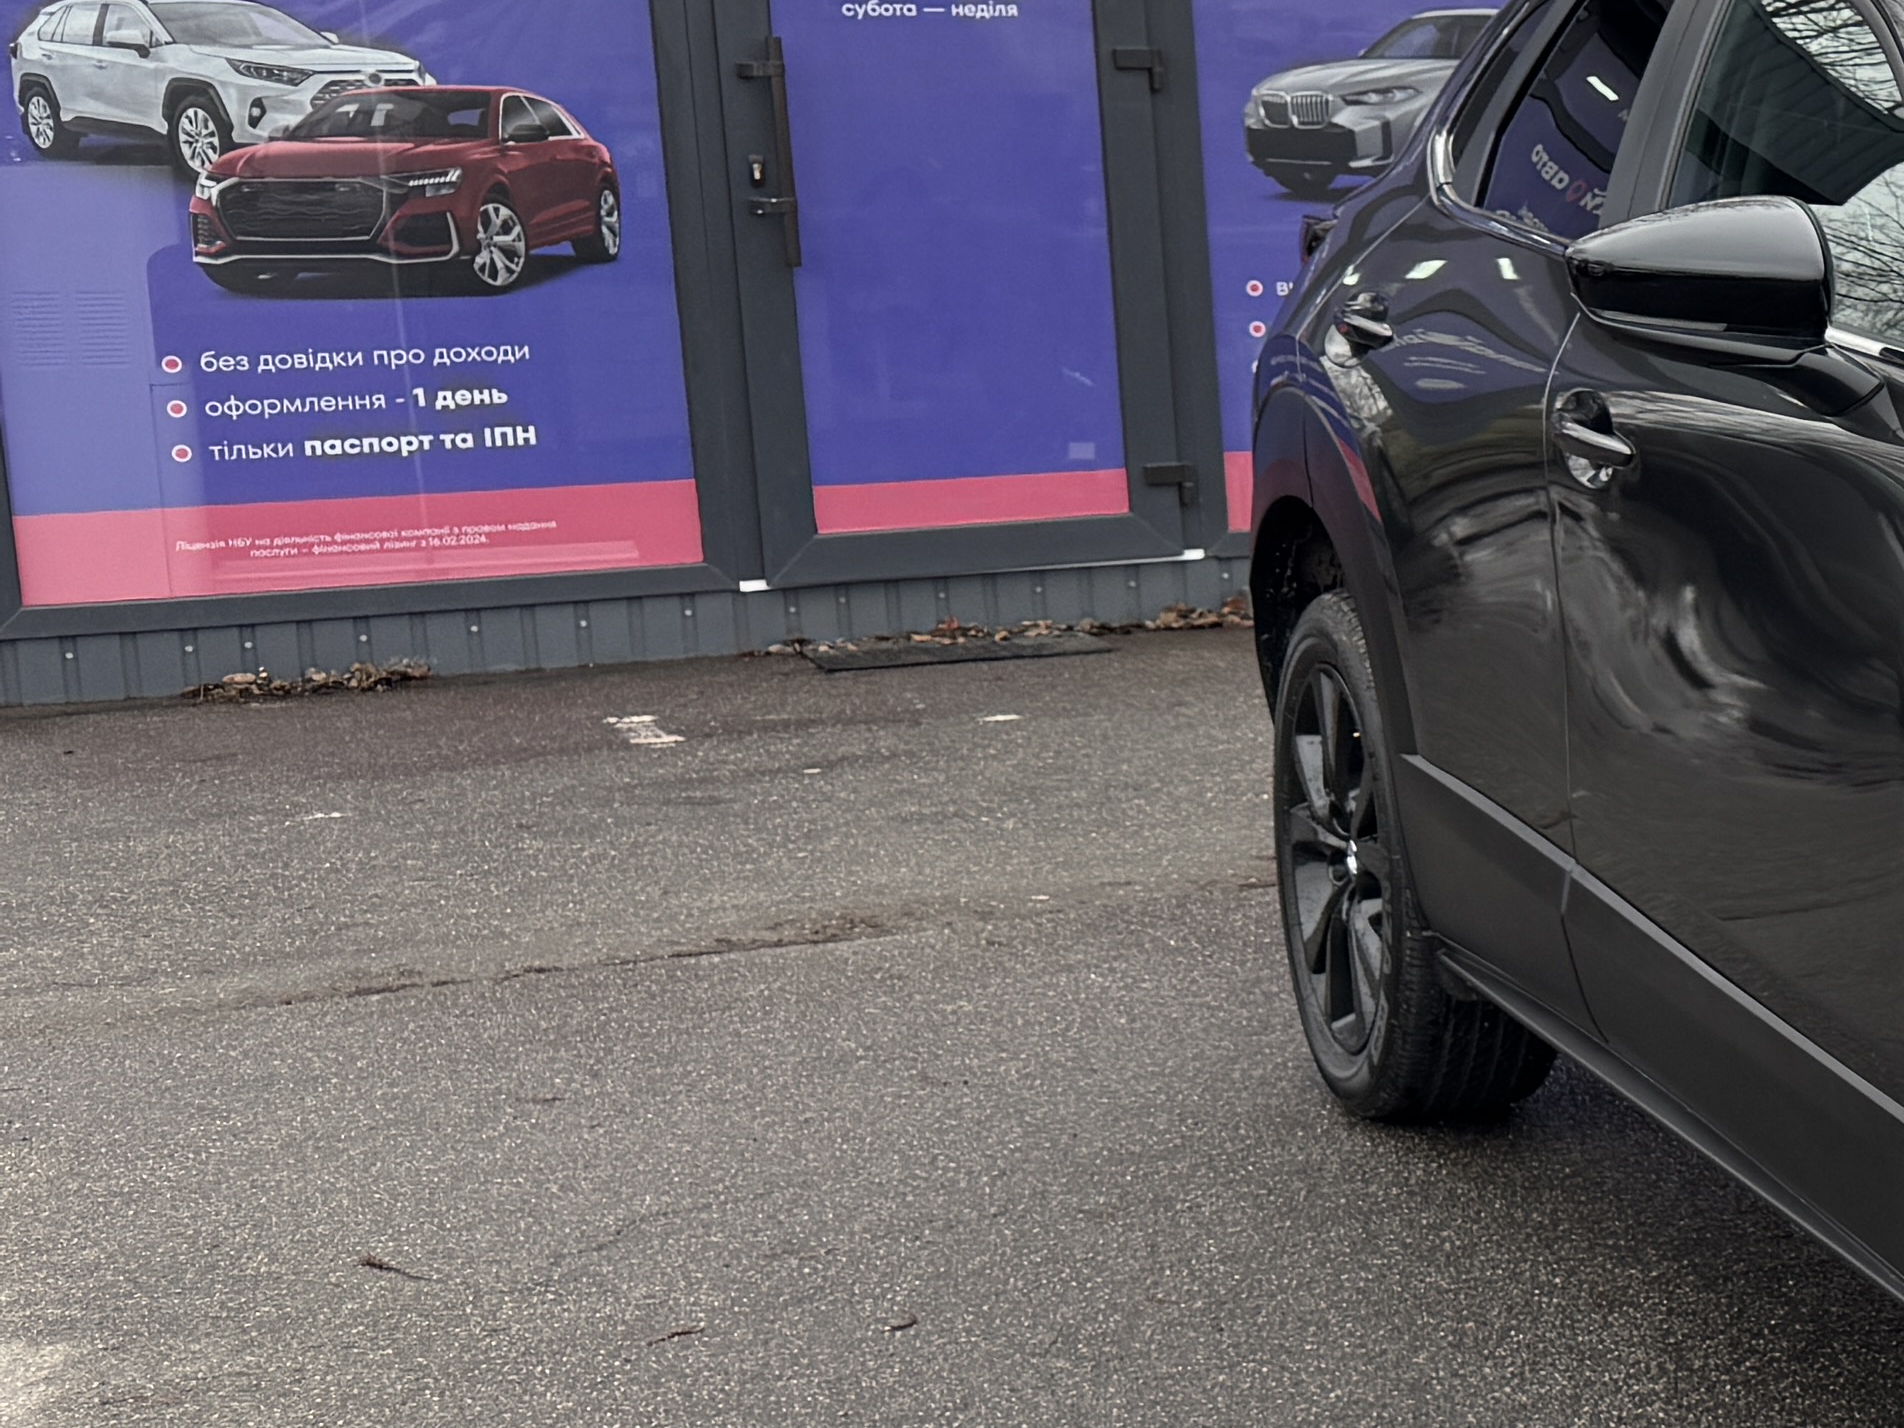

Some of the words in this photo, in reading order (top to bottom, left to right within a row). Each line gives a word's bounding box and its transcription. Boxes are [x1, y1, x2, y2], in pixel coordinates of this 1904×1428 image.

[841, 0, 917, 21] субота
[950, 0, 1019, 20] неділя
[199, 350, 250, 374] без
[257, 346, 365, 374] довідки
[372, 347, 426, 369] про
[432, 340, 531, 369] доходи
[204, 391, 387, 420] оформлення
[413, 387, 427, 408] 1
[434, 386, 509, 412] день
[208, 437, 295, 463] тільки
[303, 430, 435, 464] паспорт
[438, 429, 475, 451] та
[483, 424, 537, 450] ІПН
